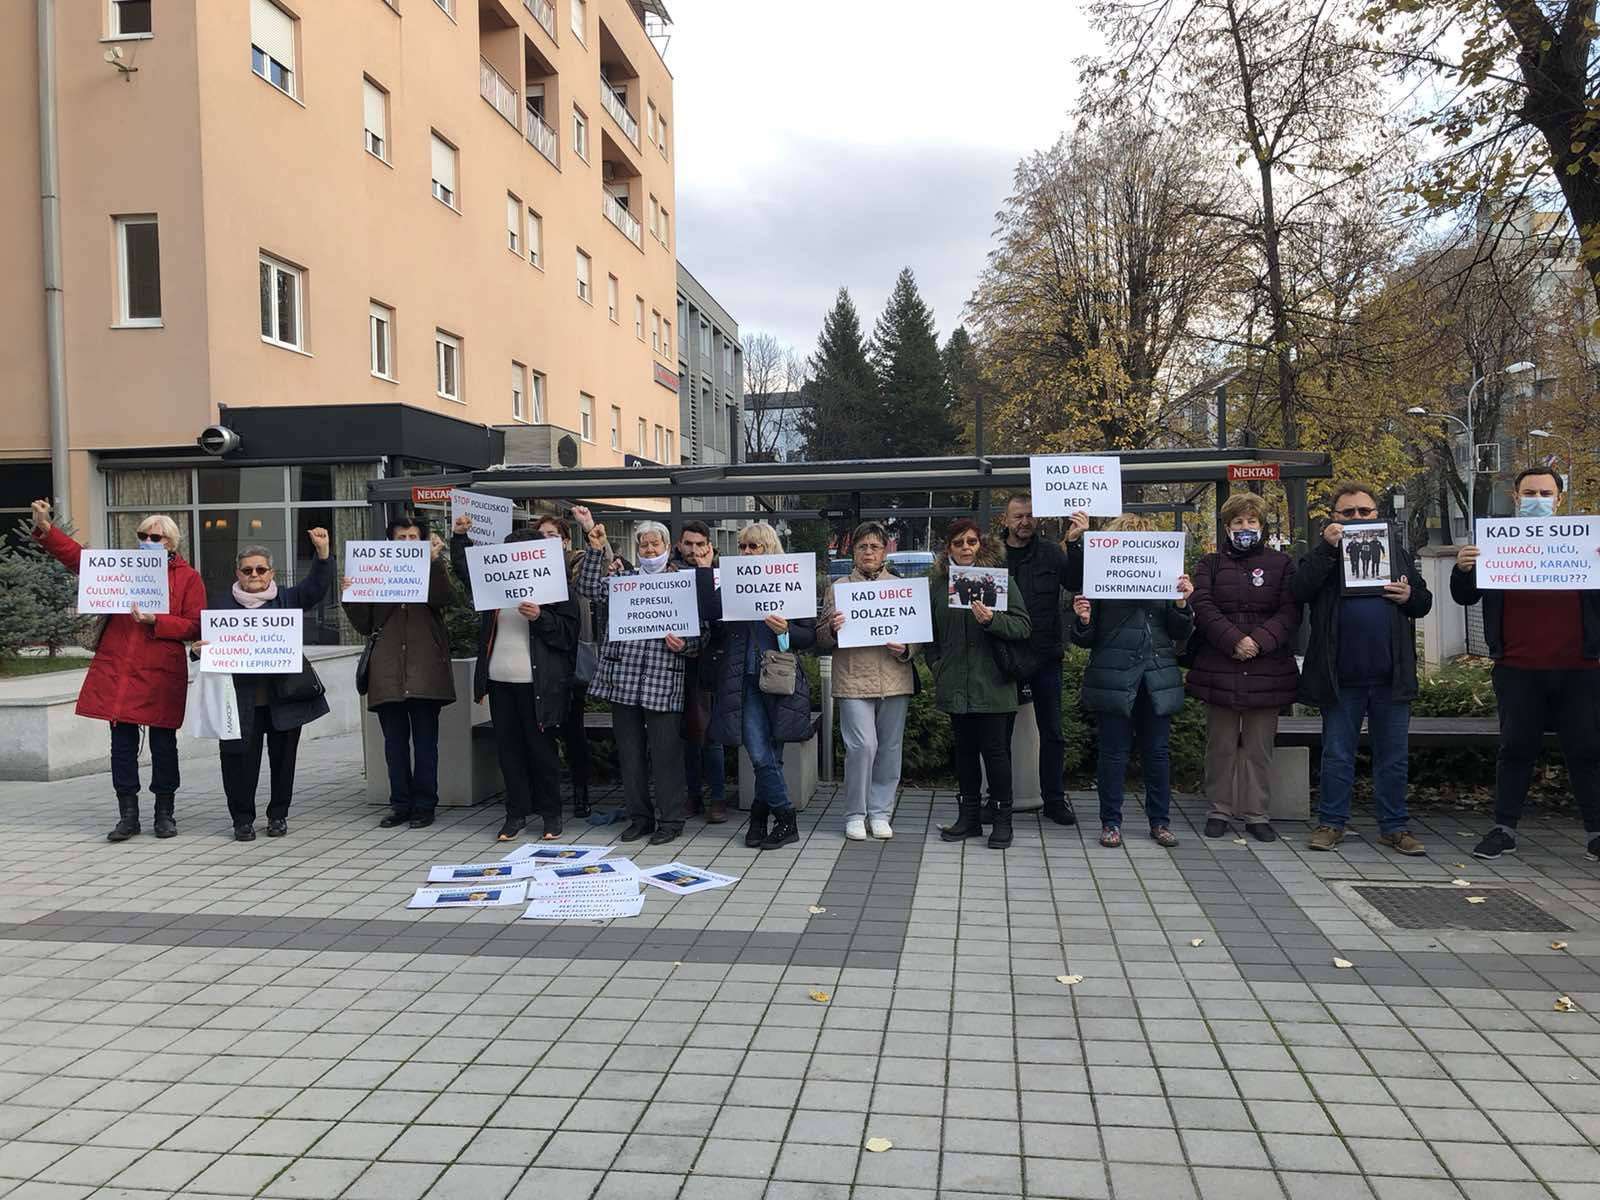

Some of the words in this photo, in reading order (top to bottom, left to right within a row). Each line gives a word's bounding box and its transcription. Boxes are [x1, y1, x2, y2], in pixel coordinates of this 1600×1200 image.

[1047, 466, 1070, 474] KAD
[1073, 466, 1104, 474] UBICE
[1233, 468, 1274, 478] NEKTAR
[1046, 482, 1088, 491] DOLAZE
[1092, 482, 1108, 490] NA
[454, 495, 470, 506] STOP
[1064, 498, 1092, 507] RED?
[1486, 526, 1520, 538] KAD
[1526, 526, 1544, 538] SE
[1549, 525, 1589, 536] SUDI
[1090, 538, 1119, 548] STOP
[1122, 540, 1180, 549] POLICIJSKOJ
[352, 548, 376, 558] KAD
[380, 548, 392, 558] SE
[396, 548, 423, 558] SUDI
[1497, 544, 1544, 555] LUKAČU,
[1548, 544, 1578, 554] ILIĆU,
[484, 554, 508, 564] KAD
[512, 549, 546, 562] UBICE
[1110, 556, 1158, 565] REPRESIJI,
[89, 557, 116, 568] KAD
[120, 557, 133, 568] SE
[136, 557, 162, 568] SUDI
[1540, 560, 1591, 569] KARANU,
[484, 570, 530, 582] DOLAZE
[534, 568, 551, 578] NA
[737, 566, 761, 576] KAD
[765, 564, 799, 574] UBICE
[1106, 570, 1156, 578] PROGONU
[1531, 574, 1588, 584] LEPIRU???
[613, 582, 637, 592] STOP
[640, 580, 691, 590] POLICIJSKOJ
[736, 583, 781, 594] DOLAZE
[786, 582, 802, 592] NA
[1095, 584, 1172, 592] DISKRIMINACIJI!
[130, 588, 164, 596] KARANU,
[505, 586, 534, 598] RED?
[852, 591, 876, 601] KAD
[880, 588, 912, 600] UBICE
[630, 596, 672, 606] REPRESIJI,
[755, 600, 784, 611] RED?
[628, 610, 672, 620] PROGONU
[851, 608, 896, 620] DOLAZE
[900, 606, 916, 616] NA
[210, 618, 238, 628] KAD
[244, 617, 258, 627] SE
[262, 616, 294, 626] SUDI
[618, 623, 688, 634] DISKRIMINACIJI!
[870, 624, 899, 636] RED?
